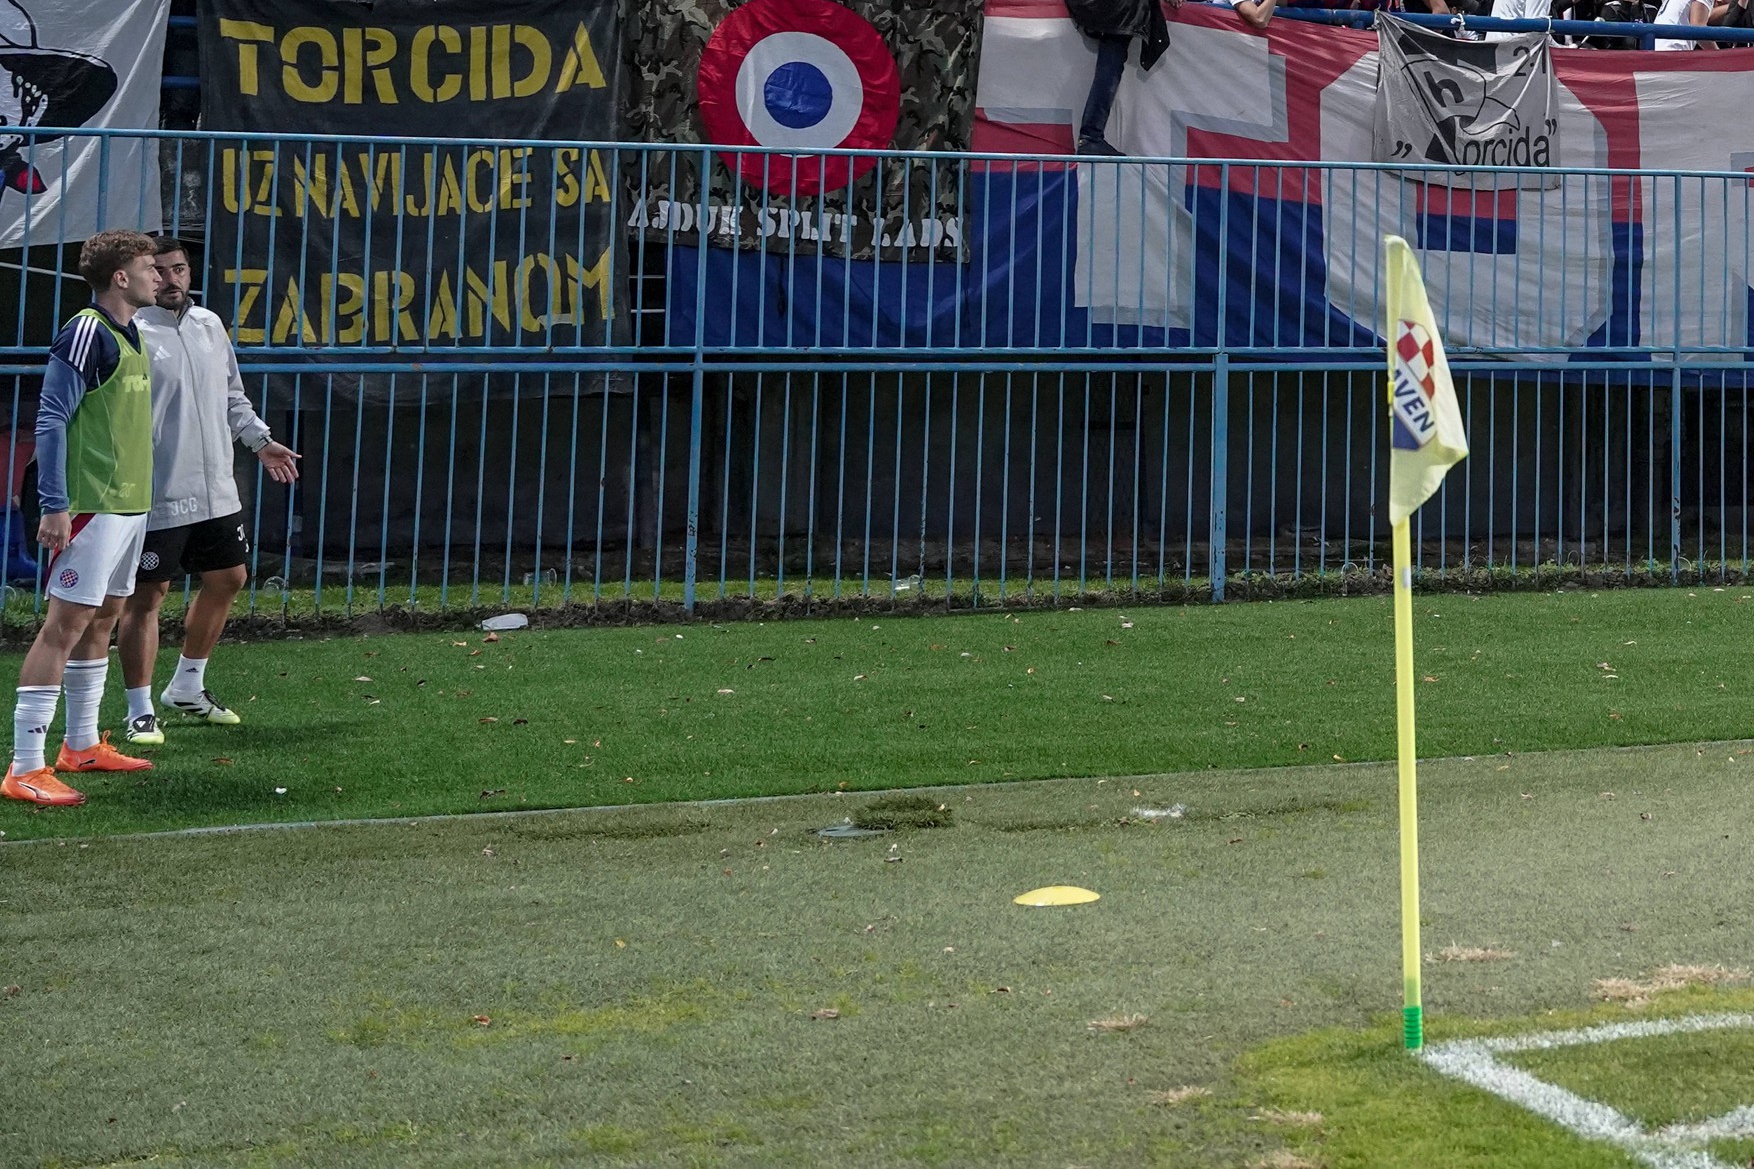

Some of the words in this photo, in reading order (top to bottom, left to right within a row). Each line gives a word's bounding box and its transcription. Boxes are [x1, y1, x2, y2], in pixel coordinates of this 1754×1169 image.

[219, 17, 608, 105] TORCIDA
[221, 148, 283, 218] UZ
[553, 147, 612, 207] SA
[756, 207, 858, 243] SPLIT
[871, 216, 965, 248] LADS
[224, 245, 616, 345] ZABRANOM
